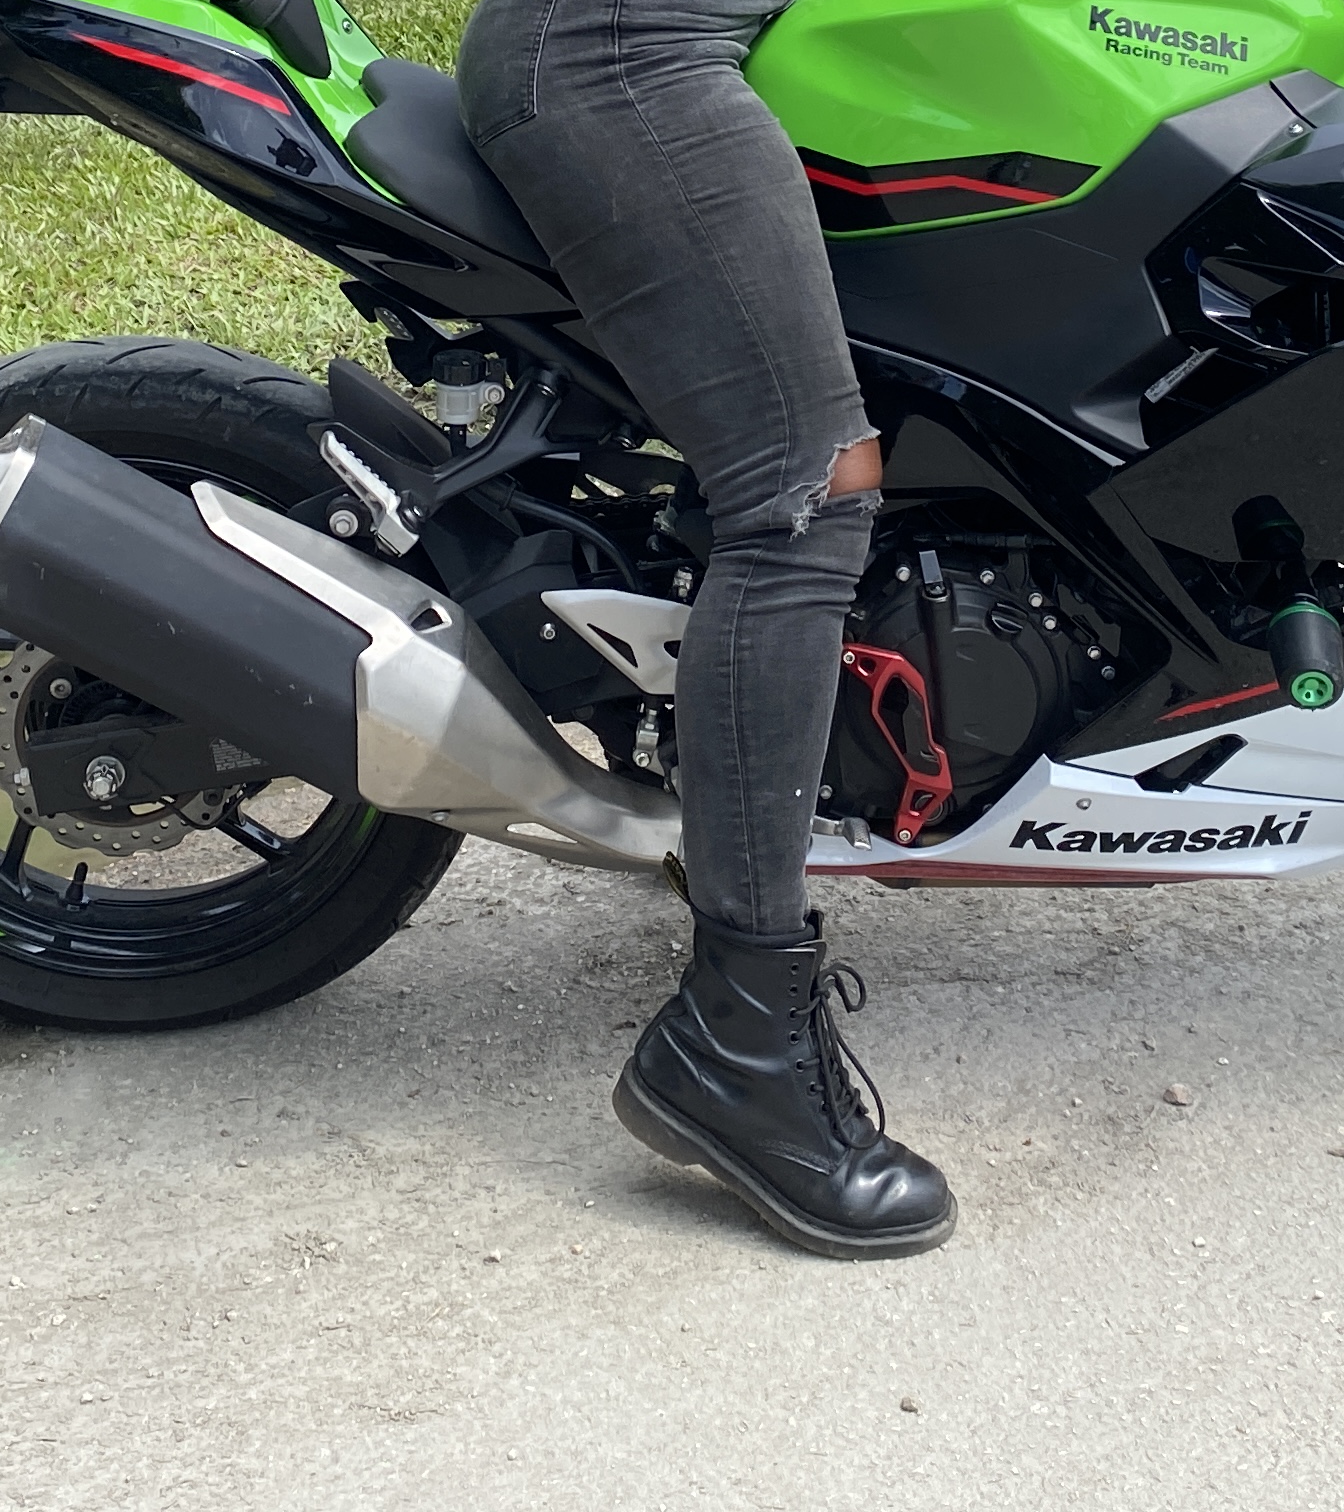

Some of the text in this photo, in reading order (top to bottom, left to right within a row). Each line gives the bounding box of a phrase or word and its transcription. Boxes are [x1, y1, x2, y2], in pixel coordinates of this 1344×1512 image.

[1088, 4, 1249, 62] Kawasaki
[1105, 38, 1229, 75] Racing Team
[1009, 810, 1313, 854] Kawasaki
